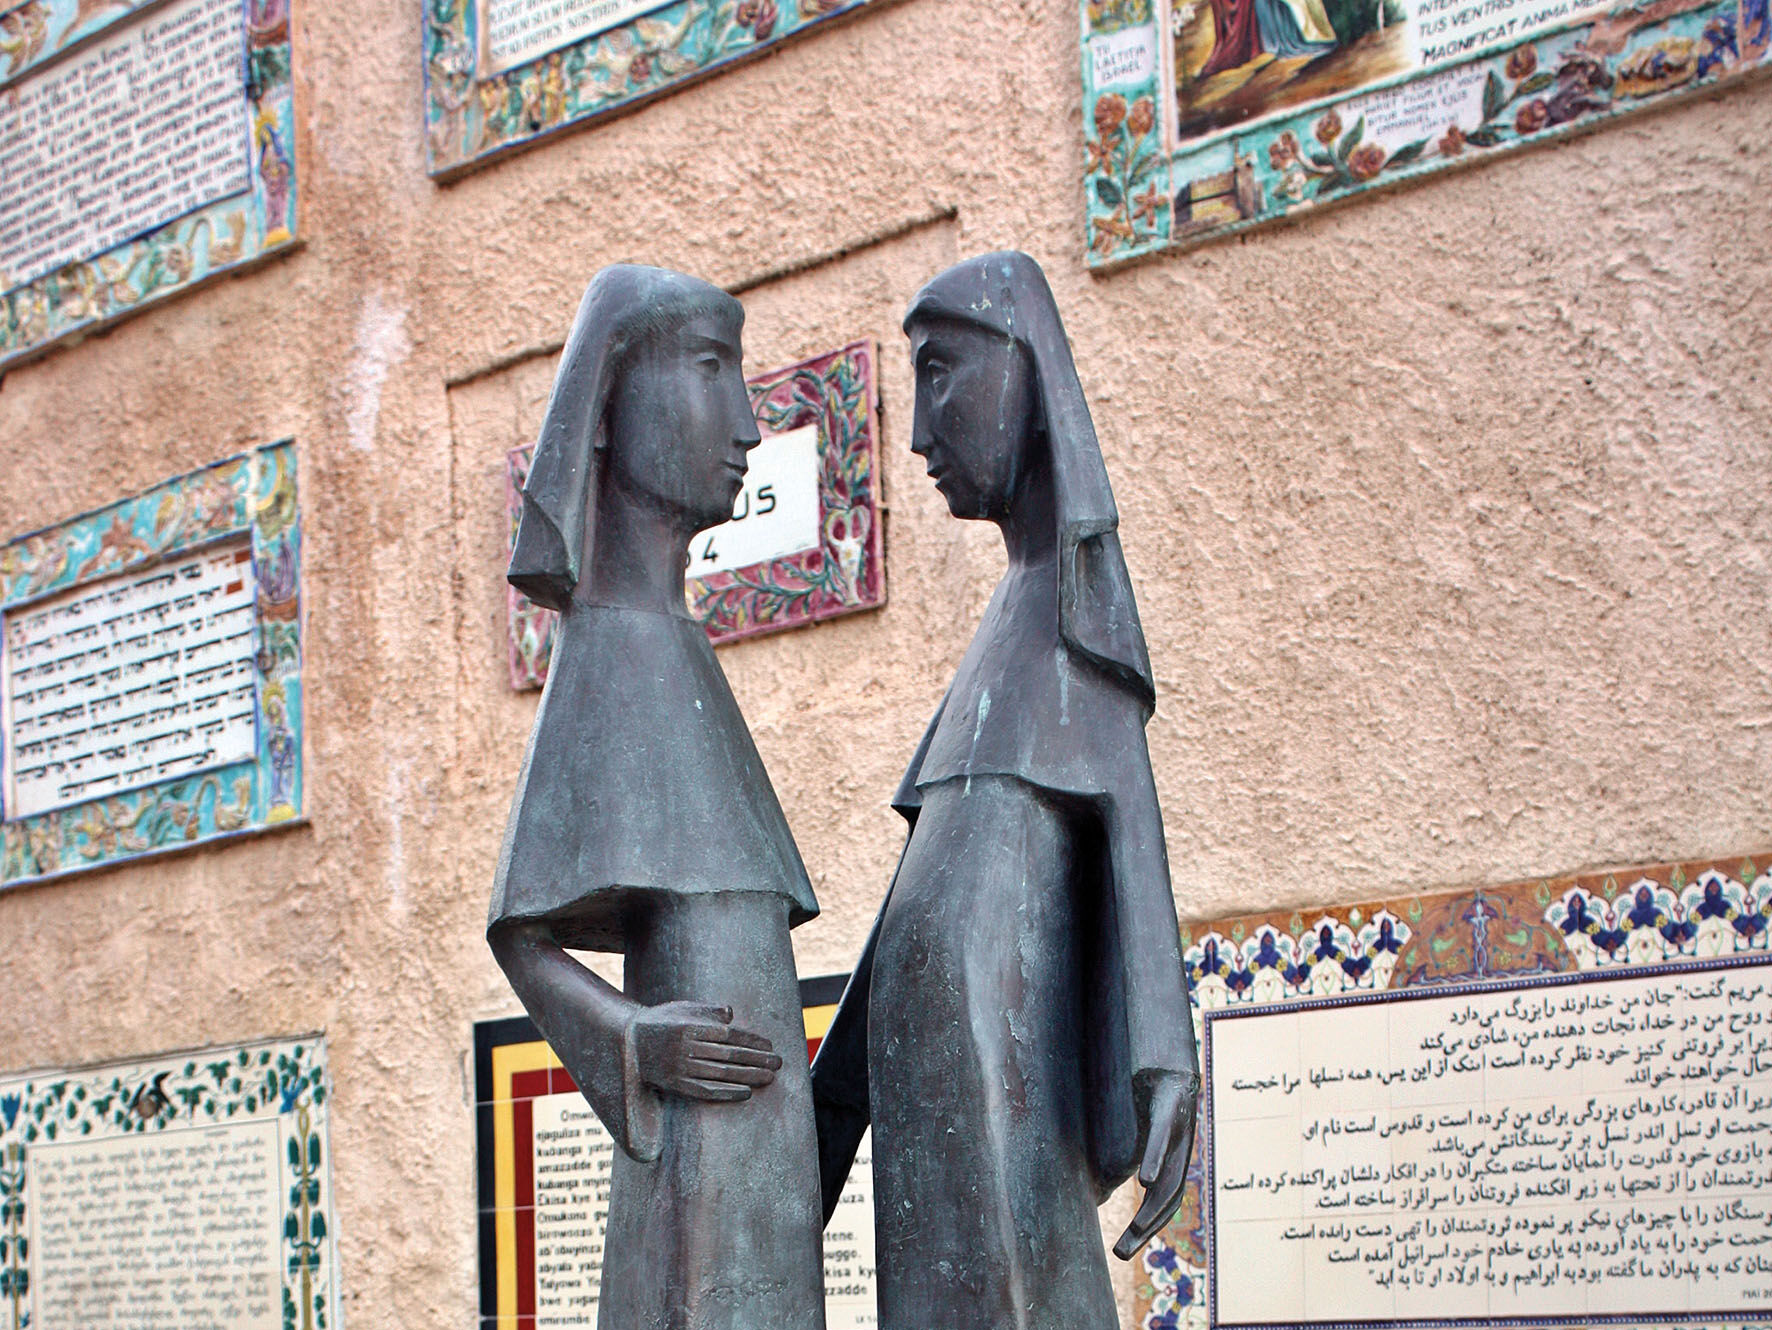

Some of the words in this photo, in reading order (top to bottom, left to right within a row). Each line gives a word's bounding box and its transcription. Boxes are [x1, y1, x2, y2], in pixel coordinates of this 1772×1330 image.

[1419, 17, 1447, 39] TUS
[1420, 18, 1518, 65] MAGNIFICAT
[1727, 984, 1764, 1002] مریم
[1504, 997, 1542, 1024] بزرگ
[1543, 997, 1556, 1019] را
[1619, 997, 1640, 1016] من
[1542, 1024, 1586, 1039] دهنده
[1591, 1016, 1636, 1036] نجات
[1639, 1013, 1676, 1032] خدا،
[1679, 1015, 1698, 1032] در
[1702, 1014, 1724, 1033] من
[1728, 1011, 1762, 1035] روح
[1467, 1024, 1509, 1051] شادی
[1512, 1031, 1540, 1049] من،
[1529, 1046, 1564, 1070] کرده
[1564, 1044, 1593, 1071] نظر
[1596, 1045, 1630, 1065] خود
[1632, 1038, 1666, 1065] کنیز
[1728, 1040, 1744, 1057] بر
[1433, 1056, 1449, 1079] از
[1490, 1050, 1526, 1070] است
[1309, 1066, 1345, 1090] نسلها
[1347, 1068, 1373, 1081] همه
[1410, 1058, 1432, 1083] این
[1231, 1075, 1279, 1093] خجسته
[1282, 1073, 1302, 1096] مرا
[1721, 1084, 1740, 1111] آن
[1438, 1109, 1473, 1128] است
[1476, 1106, 1510, 1132] کرده
[1512, 1112, 1533, 1131] من
[1536, 1104, 1569, 1128] برای
[1572, 1098, 1618, 1128] بزرگی
[585, 1127, 603, 1136] mu
[1321, 1118, 1342, 1147] نام
[1343, 1115, 1377, 1135] است
[1379, 1113, 1424, 1139] قدوس
[1425, 1119, 1436, 1134] و
[1633, 1122, 1665, 1145] اندر
[1668, 1120, 1702, 1147] نسل
[1704, 1117, 1721, 1140] او
[1577, 1135, 1591, 1151] بر
[1597, 1122, 1630, 1151] نسل
[1511, 1154, 1558, 1173] ساخته
[1610, 1150, 1624, 1172] را
[1628, 1147, 1673, 1170] قدرت
[1677, 1146, 1712, 1169] خود
[1715, 1141, 1764, 1166] بازوی
[1339, 1164, 1381, 1186] دلشان
[1383, 1162, 1418, 1185] افکار
[1419, 1166, 1437, 1183] در
[1440, 1161, 1453, 1181] را
[1219, 1173, 1255, 1190] است.
[1257, 1171, 1288, 1195] کرده
[1574, 1180, 1599, 1202] زیر
[1603, 1181, 1616, 1199] به
[1664, 1171, 1680, 1194] از
[1685, 1171, 1697, 1193] را
[1314, 1191, 1351, 1209] است.
[1353, 1189, 1397, 1207] ساخته
[1452, 1185, 1465, 1206] را
[1577, 1208, 1611, 1234] نیکو
[1679, 1205, 1692, 1224] با
[1695, 1205, 1709, 1227] را
[1280, 1223, 1316, 1241] است.
[1354, 1224, 1392, 1238] دست
[1395, 1221, 1422, 1244] تهی
[1425, 1218, 1438, 1238] را
[1514, 1214, 1556, 1236] نموده
[1557, 1219, 1574, 1236] پر
[1363, 1241, 1394, 1264] آمده
[1526, 1238, 1565, 1262] یاری
[1567, 1241, 1582, 1260] به
[1584, 1228, 1626, 1257] آورده
[1630, 1234, 1651, 1254] یاد
[1656, 1238, 1670, 1251] به
[1672, 1232, 1686, 1254] را
[1689, 1235, 1725, 1255] خود
[1327, 1247, 1361, 1264] است
[1452, 1244, 1484, 1264] خود
[1487, 1240, 1525, 1270] خادم
[1446, 1265, 1480, 1285] اولاد
[1605, 1257, 1637, 1278] گفته
[1639, 1260, 1654, 1278] ما
[1658, 1259, 1701, 1283] پدران
[1705, 1263, 1720, 1281] به
[1723, 1256, 1743, 1274] که
[1397, 1274, 1411, 1291] به
[1413, 1268, 1425, 1285] تا
[1428, 1267, 1443, 1289] او
[1483, 1271, 1496, 1288] به
[1498, 1271, 1509, 1287] و
[1563, 1269, 1577, 1285] به
